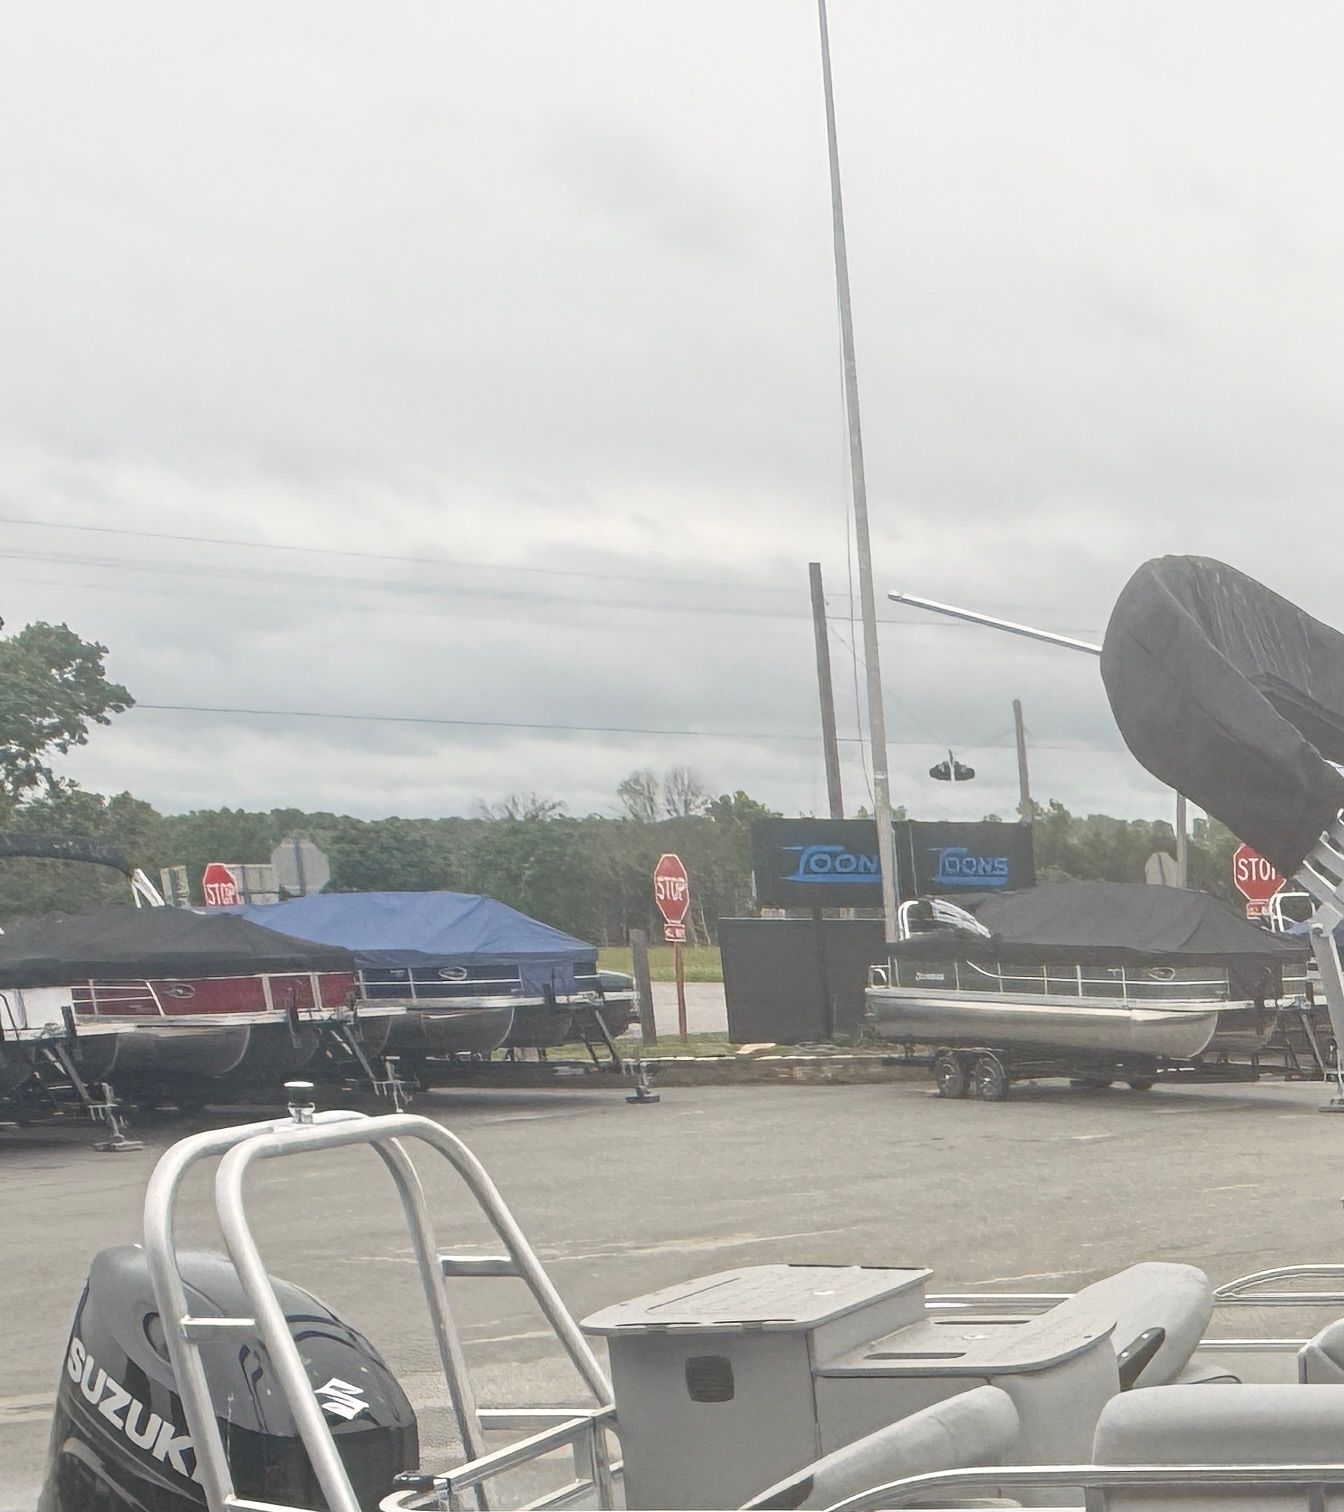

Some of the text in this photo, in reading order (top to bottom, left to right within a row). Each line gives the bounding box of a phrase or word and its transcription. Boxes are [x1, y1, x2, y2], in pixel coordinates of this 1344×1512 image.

[780, 844, 883, 884] TOON
[206, 882, 236, 905] STOP
[657, 876, 686, 901] STOP
[67, 1336, 204, 1486] SUZUK
